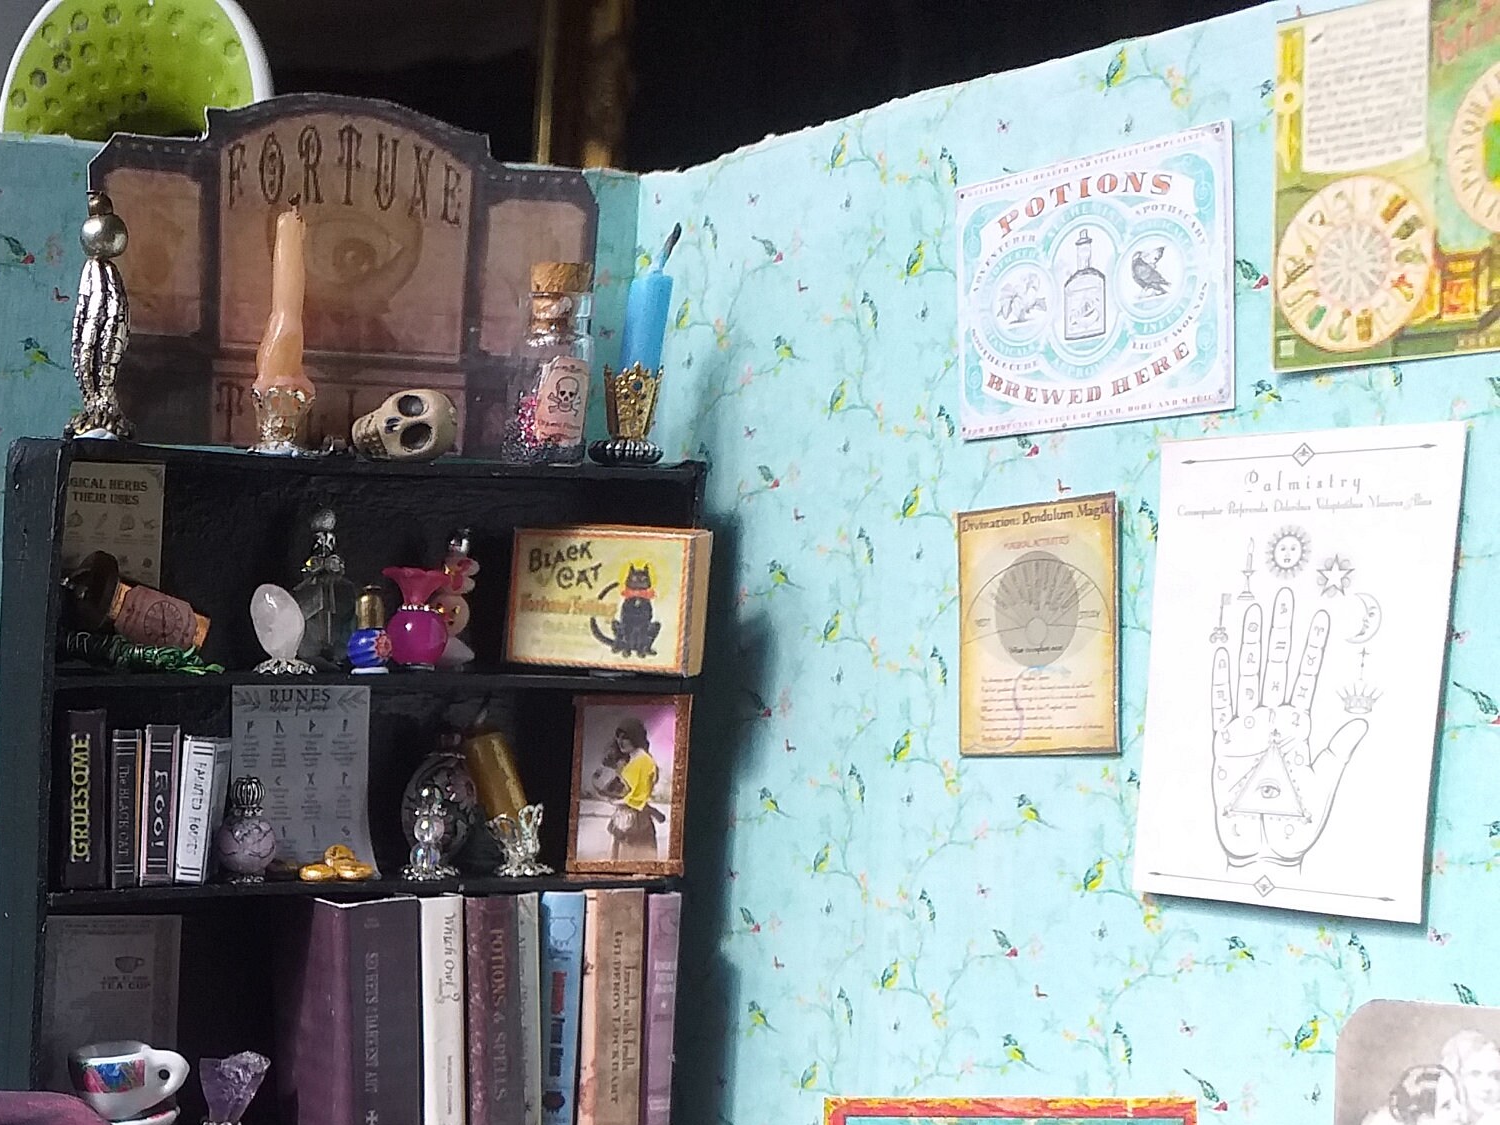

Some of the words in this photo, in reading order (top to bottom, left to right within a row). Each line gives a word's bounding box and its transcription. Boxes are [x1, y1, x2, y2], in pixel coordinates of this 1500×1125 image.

[228, 124, 462, 228] FORTUNE
[997, 171, 1173, 239] POTIONS
[986, 372, 1101, 406] BREWED
[1110, 342, 1191, 398] HERE
[72, 491, 107, 504] THEIR
[110, 493, 140, 505] USES
[109, 479, 148, 492] HERBS
[1244, 468, 1361, 494] Palmistry
[1021, 509, 1074, 527] Pendulum
[1076, 501, 1112, 520] Magik
[556, 563, 602, 589] CAT
[269, 688, 331, 701] RUNES
[72, 738, 90, 858] GRUESOME
[117, 787, 130, 828] BLACK
[117, 831, 130, 857] CAT
[444, 912, 457, 956] Which
[100, 981, 123, 991] TEA
[128, 981, 151, 991] CUP
[491, 928, 505, 1006] POTIONS
[611, 931, 624, 1010] GILDEROY
[493, 1031, 507, 1103] SPELLS
[609, 1016, 622, 1104] LOCKHART
